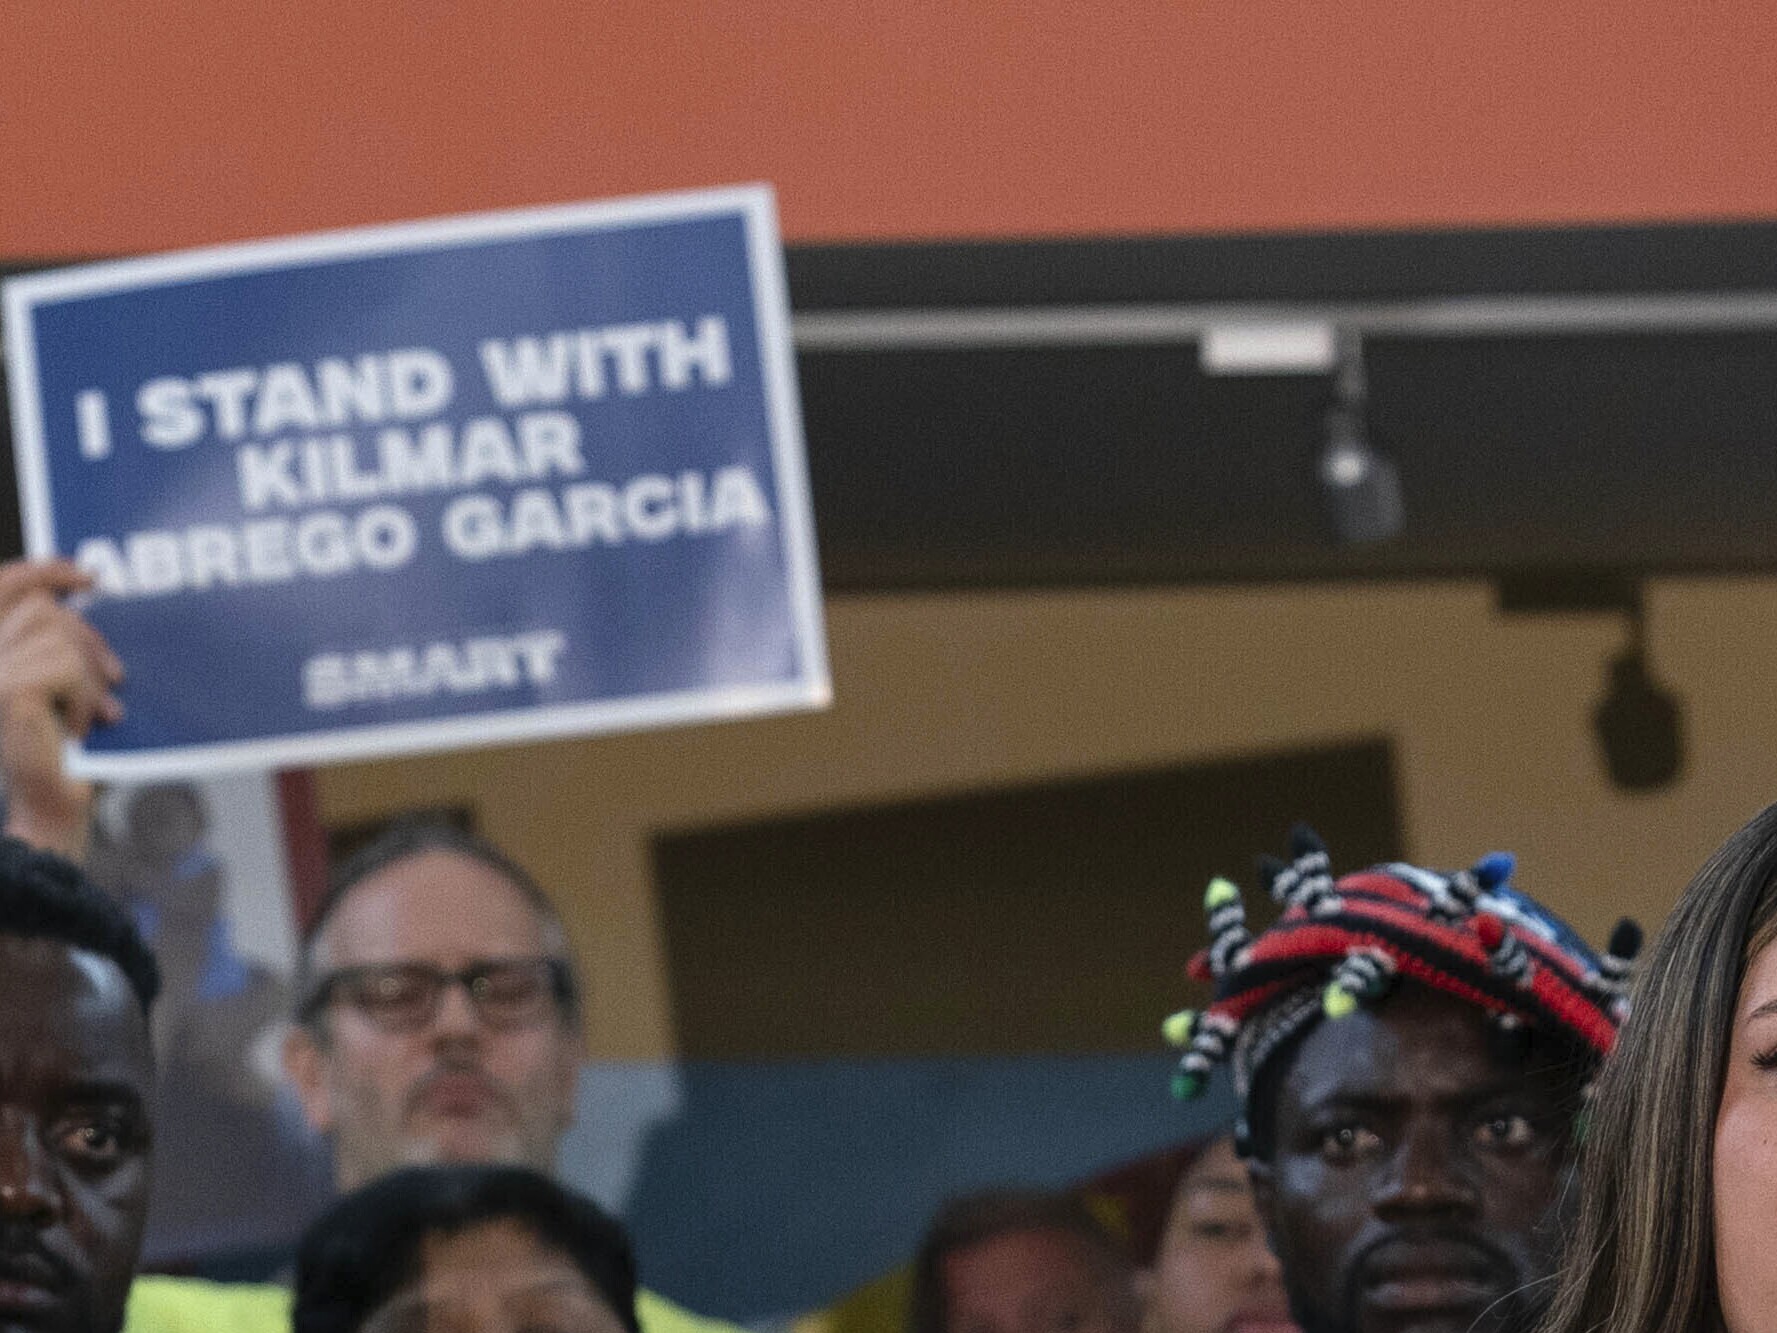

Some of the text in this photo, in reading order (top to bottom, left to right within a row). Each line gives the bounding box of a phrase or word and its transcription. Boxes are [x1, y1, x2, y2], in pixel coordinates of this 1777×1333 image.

[80, 319, 728, 455] I STAND WITH
[240, 414, 579, 510] KILMAR
[76, 467, 770, 595] ABREGO GARCIA
[308, 633, 562, 703] SMART
